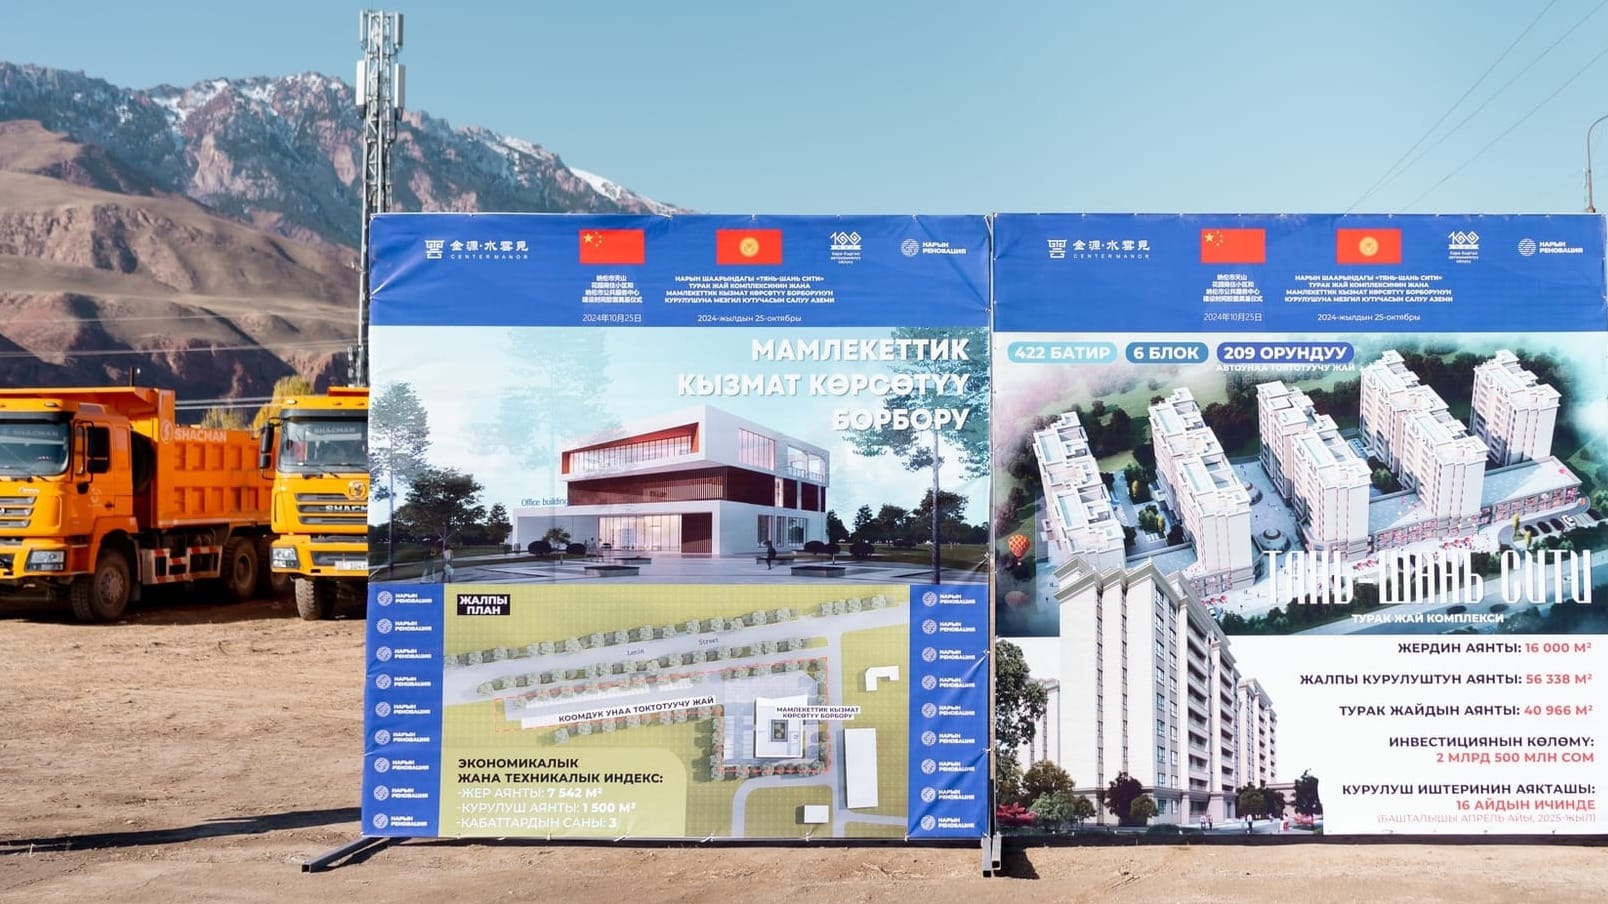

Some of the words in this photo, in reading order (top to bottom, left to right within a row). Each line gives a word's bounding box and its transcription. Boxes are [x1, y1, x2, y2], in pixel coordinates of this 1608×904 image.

[702, 275, 754, 283] ШААРЫНДАГЫ
[712, 281, 728, 289] ЖАЙ
[1332, 280, 1348, 288] ЖАЙ
[1350, 281, 1406, 289] КОМПЛЕКСИНИН
[666, 289, 717, 297] МАМЛЕКЕТТИК
[719, 289, 748, 297] КЫЗМАТ
[750, 289, 785, 297] КӨРСӨТҮҮ
[787, 289, 833, 297] БОРБОРУНУН
[583, 314, 641, 322] 2024年10月25日
[698, 314, 753, 322] 2024-жылдын
[756, 314, 801, 322] 25-октябры
[1204, 313, 1262, 321] 2024年10月25日
[1318, 313, 1372, 321] 2024-жылдын
[1375, 313, 1420, 321] 25-октябры
[752, 339, 968, 361] МАМЛЕКЕТТИК
[1016, 347, 1045, 359] 422
[1052, 347, 1110, 359] БАТИР
[1134, 347, 1144, 359] 6
[1150, 347, 1198, 359] БЛОК
[1224, 347, 1255, 359] 209
[1261, 347, 1346, 362] ОРУНДУУ
[678, 374, 800, 396] КЫЗМАТ
[810, 374, 969, 396] КӨРСӨТҮҮ
[834, 408, 968, 430] БОРБОРУ
[174, 430, 227, 442] SHACMAN
[521, 498, 540, 506] Office
[460, 596, 507, 605] ЖАЛПЫ
[467, 606, 500, 615] ПЛАН
[1352, 614, 1390, 623] ТУРАК
[1395, 613, 1423, 623] ЖАЙ
[1428, 614, 1504, 623] КОМПЛЕКСИ
[1398, 643, 1460, 654] ЖЕРДИН
[1466, 643, 1521, 653] АЯНТЫ:
[1526, 643, 1538, 653] 16
[1544, 643, 1569, 653] 000
[1574, 643, 1591, 653] М²
[1300, 675, 1358, 684] ЖАЛПЫ
[1363, 674, 1461, 684] КУРУЛУШТУН
[1466, 674, 1522, 684] АЯНТЫ:
[1526, 674, 1542, 684] 56
[1546, 674, 1570, 684] 338
[1575, 674, 1592, 684] М²
[558, 711, 604, 723] КООМДУК
[606, 708, 631, 718] УНАА
[633, 700, 691, 714] ТОКТОТУУЧУ
[692, 696, 715, 708] ЖАЙ
[1339, 706, 1385, 716] ТУРАК
[1390, 703, 1459, 717] ЖАЙДЫН
[1464, 706, 1520, 715] АЯНТЫ:
[1524, 706, 1541, 715] 40
[1546, 706, 1571, 715] 966
[1576, 705, 1592, 715] М²
[1390, 737, 1522, 748] ИНВЕСТИЦИЯНЫН
[1528, 737, 1594, 746] КӨЛӨМҮ:
[1436, 753, 1444, 762] 2
[1448, 753, 1490, 764] МЛРД
[1495, 752, 1520, 762] 500
[1524, 752, 1557, 762] МЛН
[1562, 752, 1594, 762] СОМ
[459, 759, 578, 768] ЭКОНОМИКАЛЫК
[458, 774, 500, 782] ЖАНА
[505, 774, 600, 782] ТЕХНИКАЛЫК
[604, 774, 662, 784] ИНДЕКС:
[457, 788, 491, 798] -ЖЕР
[494, 788, 544, 798] АЯНТЫ:
[547, 788, 555, 797] 7
[559, 788, 582, 798] 542
[586, 788, 602, 798] М²
[1343, 784, 1413, 794] КУРУЛУШ
[1418, 784, 1511, 794] ИШТЕРИНИН
[1516, 784, 1595, 794] АЯКТАШЫ:
[456, 803, 525, 814] -КУРУЛУШ
[530, 803, 578, 813] АЯНТЫ:
[582, 803, 588, 813] 1
[592, 803, 615, 813] 500
[619, 802, 635, 813] М²
[1456, 800, 1470, 810] 16
[1474, 799, 1530, 812] АЙДЫН
[1535, 800, 1595, 812] ИЧИНДЕ
[457, 818, 560, 829] -КАБАТТАРДЫН
[563, 818, 606, 828] САНЫ:
[609, 818, 618, 828] 3
